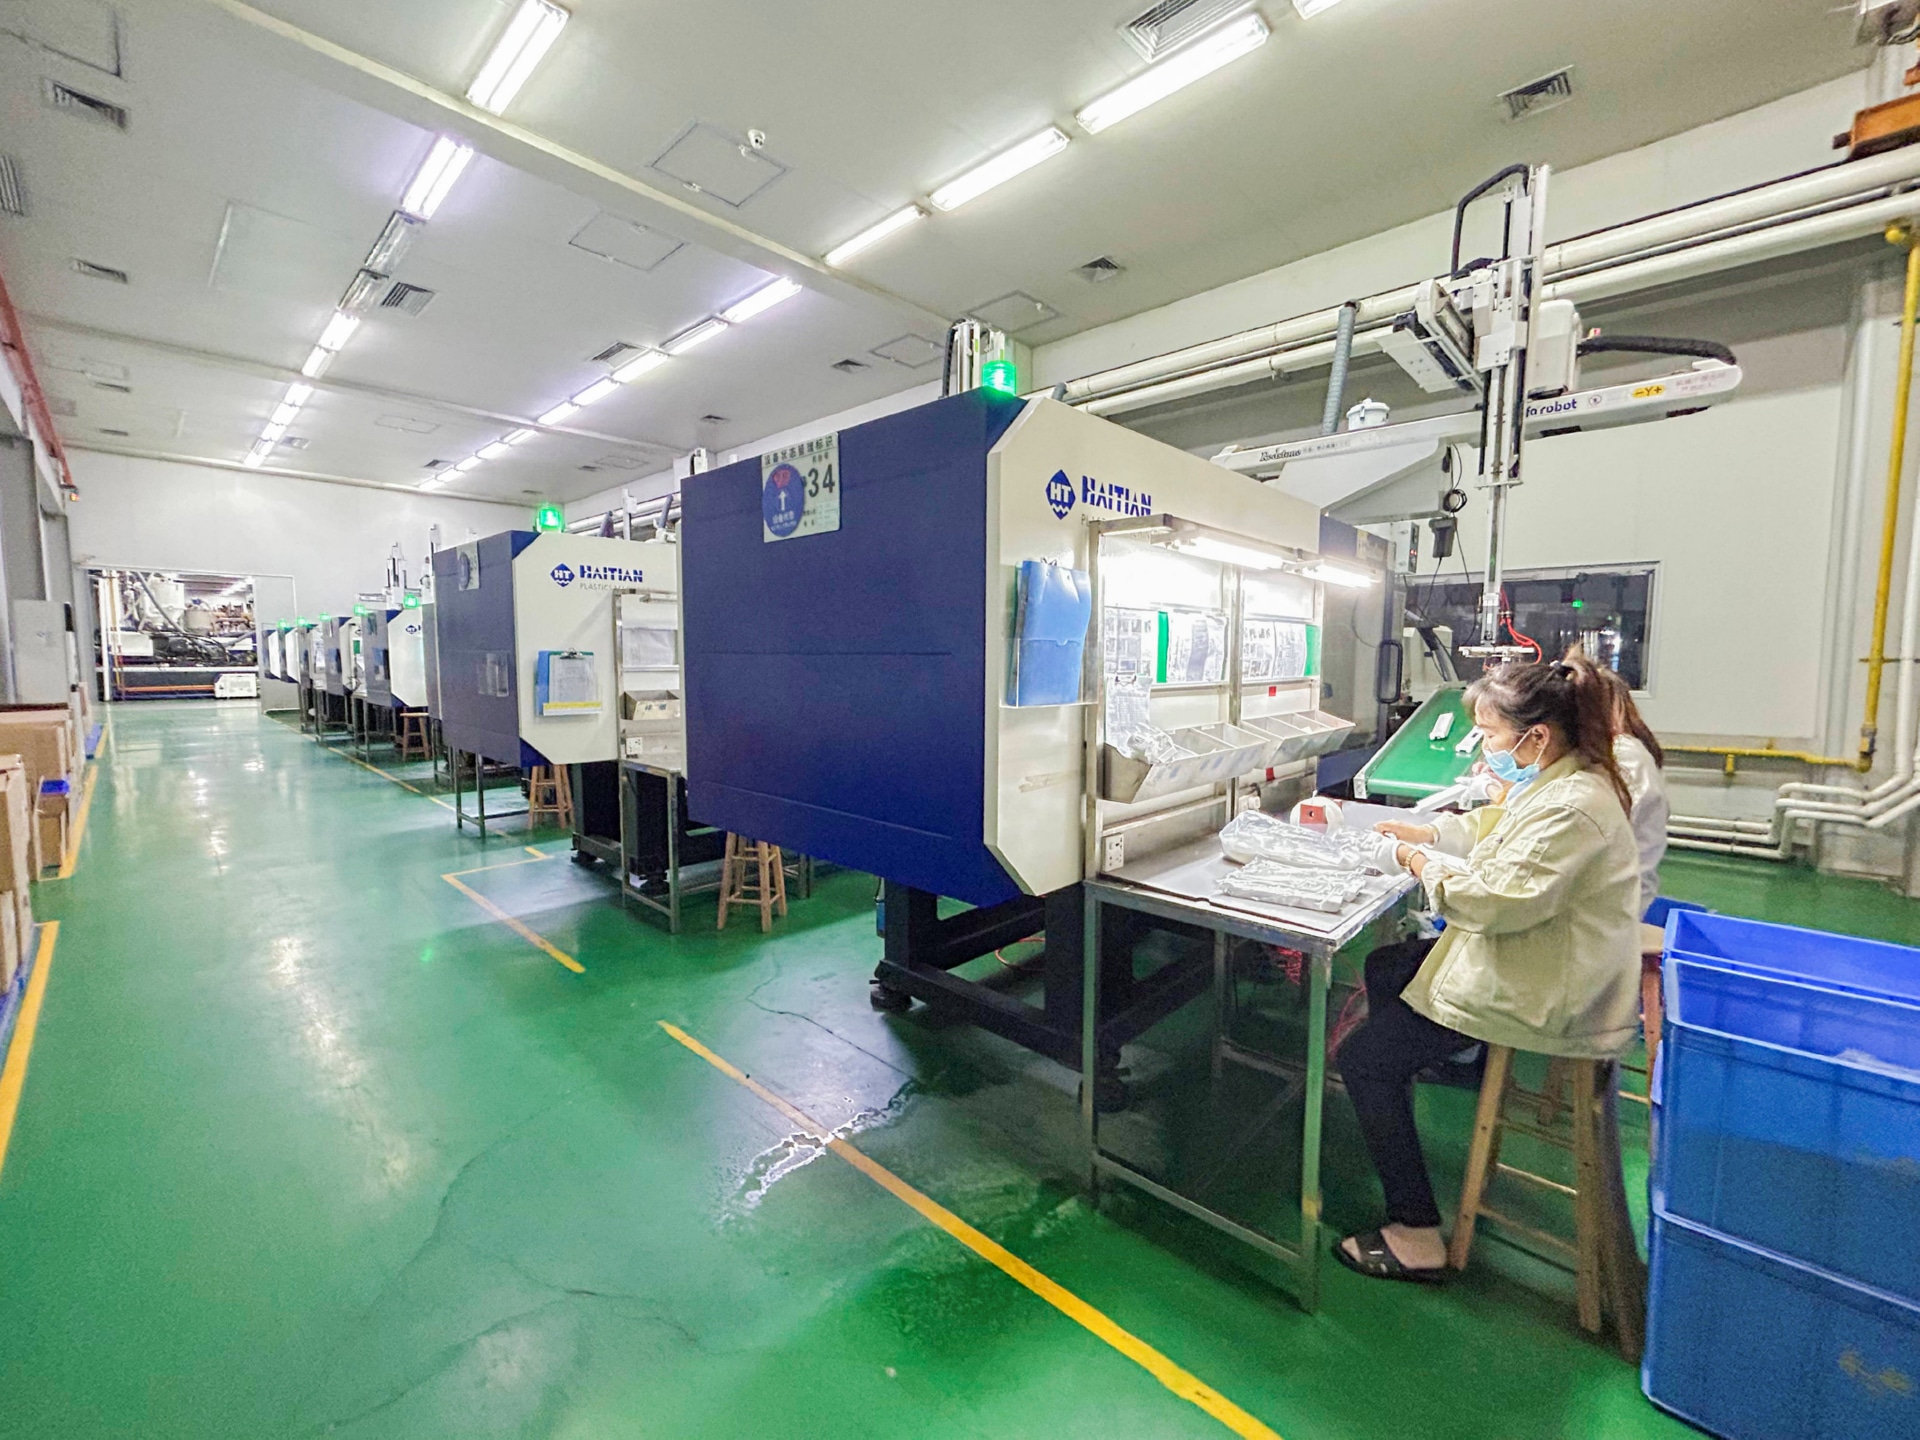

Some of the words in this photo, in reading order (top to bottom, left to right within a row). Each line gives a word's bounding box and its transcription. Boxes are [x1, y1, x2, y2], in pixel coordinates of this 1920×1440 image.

[1540, 399, 1577, 414] robot
[1082, 475, 1151, 516] HAITIAN
[579, 564, 643, 583] HAITIAN
